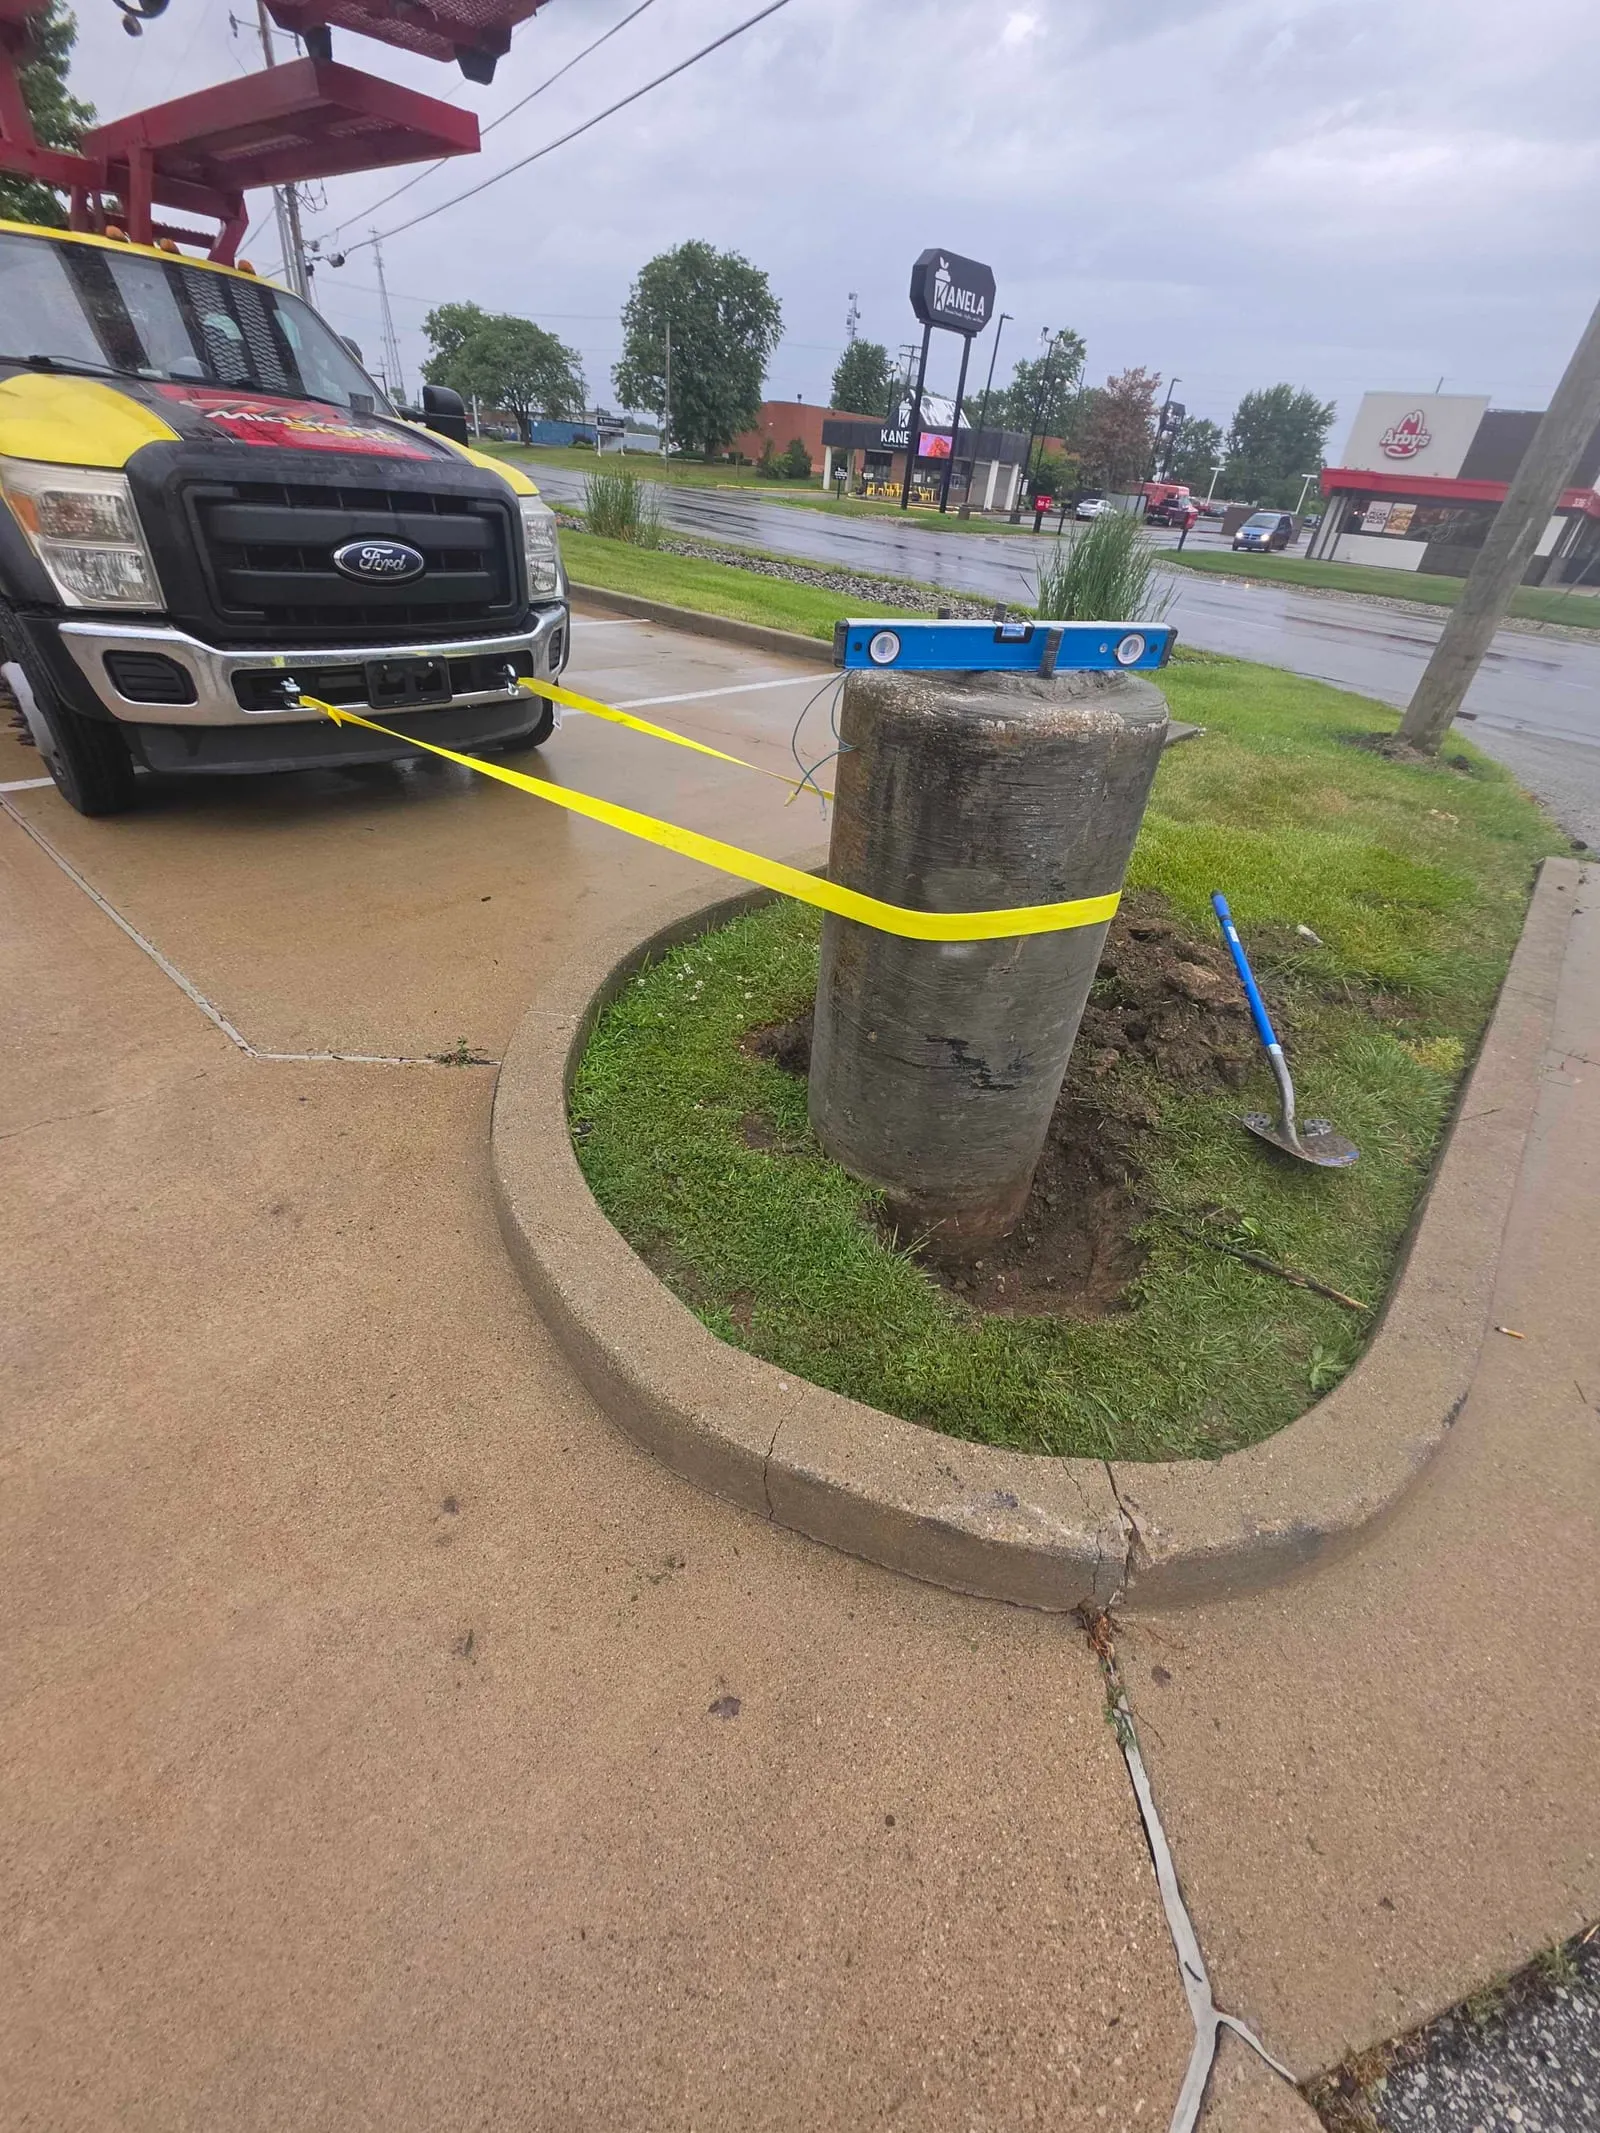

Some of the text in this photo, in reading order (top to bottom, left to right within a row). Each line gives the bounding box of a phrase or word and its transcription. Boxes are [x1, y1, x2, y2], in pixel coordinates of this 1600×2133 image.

[933, 280, 985, 317] KANELA
[880, 428, 911, 444] KANE
[1380, 429, 1430, 449] Arby's
[359, 547, 406, 571] Ford
